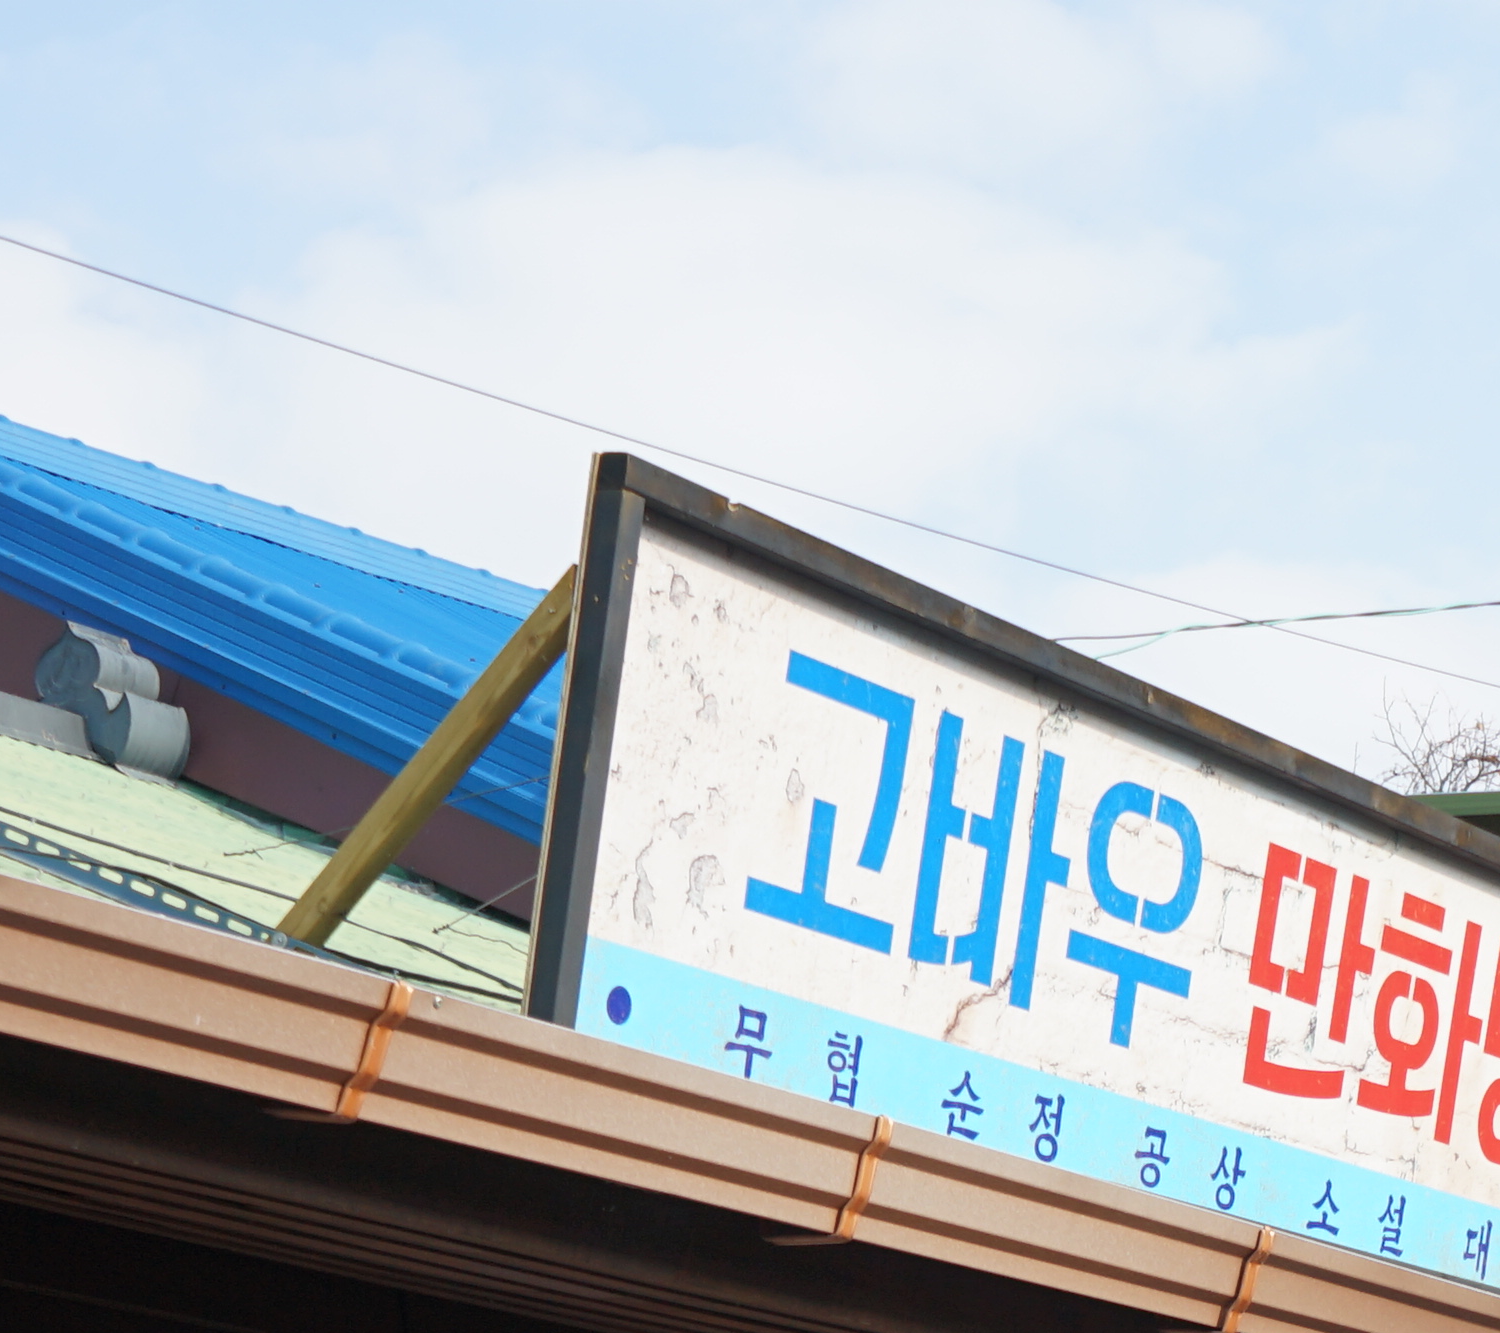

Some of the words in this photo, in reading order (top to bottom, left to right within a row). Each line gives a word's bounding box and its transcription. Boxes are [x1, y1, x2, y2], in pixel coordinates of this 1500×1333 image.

[744, 650, 1203, 1048] 고바우
[724, 1004, 864, 1108] 무협
[940, 1075, 1066, 1164] 순정
[1133, 1125, 1247, 1213] 공상
[1306, 1178, 1408, 1257] 소설
